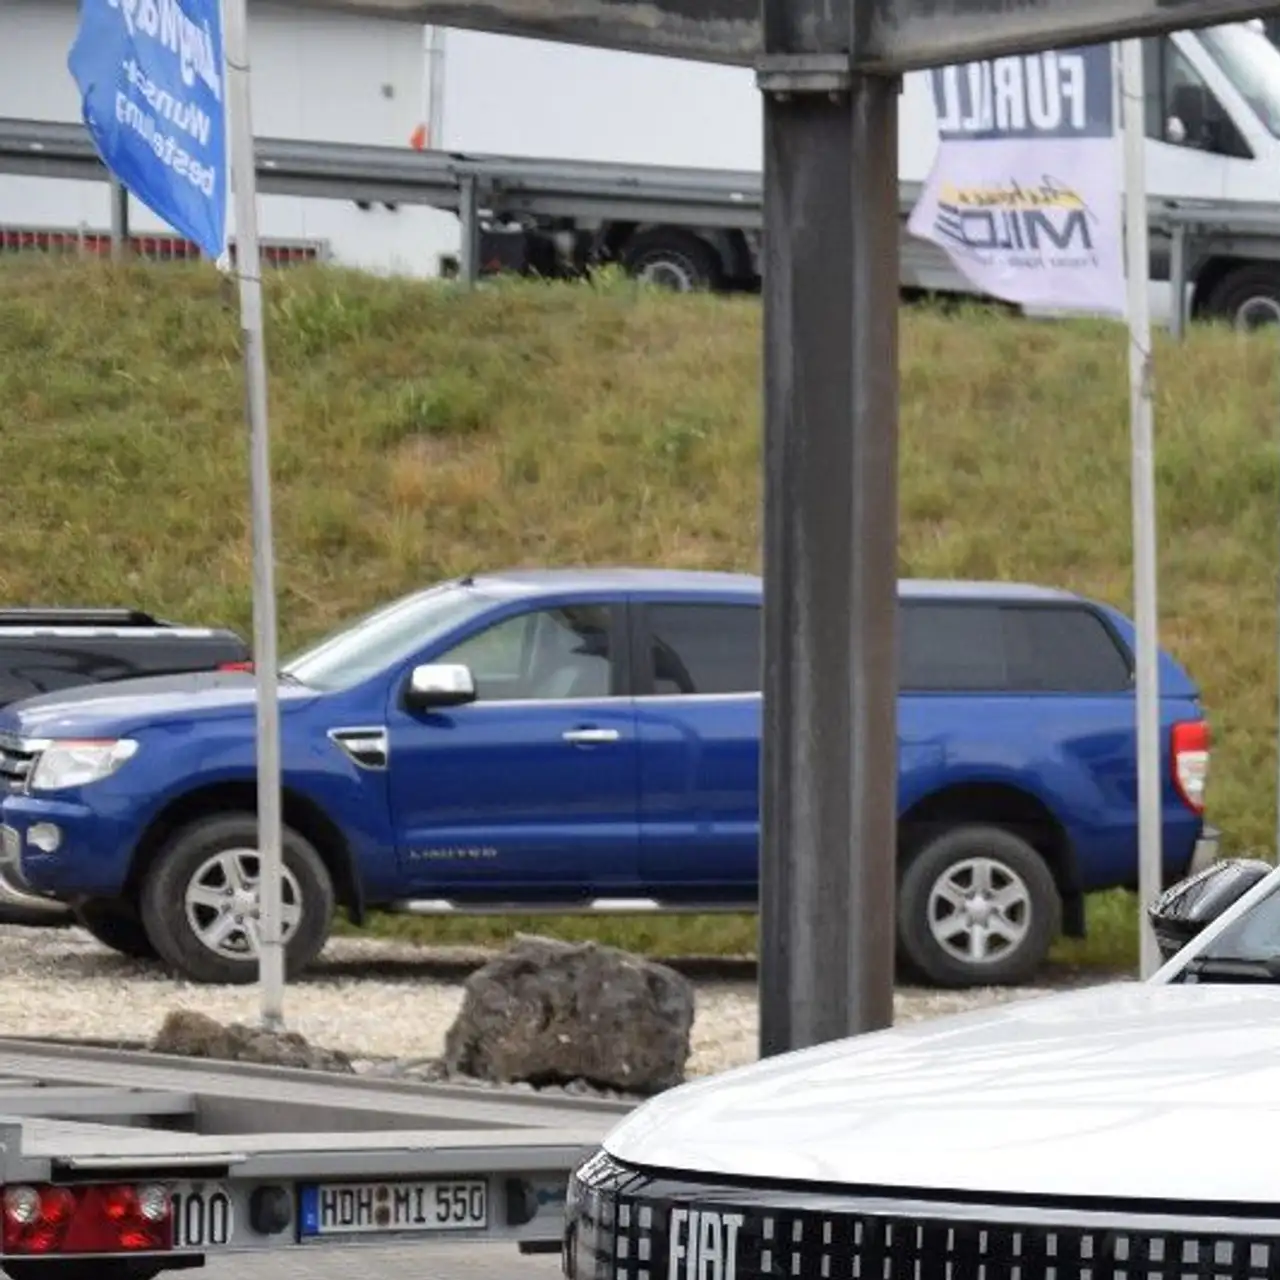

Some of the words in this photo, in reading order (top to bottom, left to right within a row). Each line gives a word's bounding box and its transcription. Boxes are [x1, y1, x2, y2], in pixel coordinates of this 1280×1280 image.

[321, 1188, 373, 1226] HDH
[394, 1186, 426, 1223] MI
[436, 1185, 484, 1222] 550
